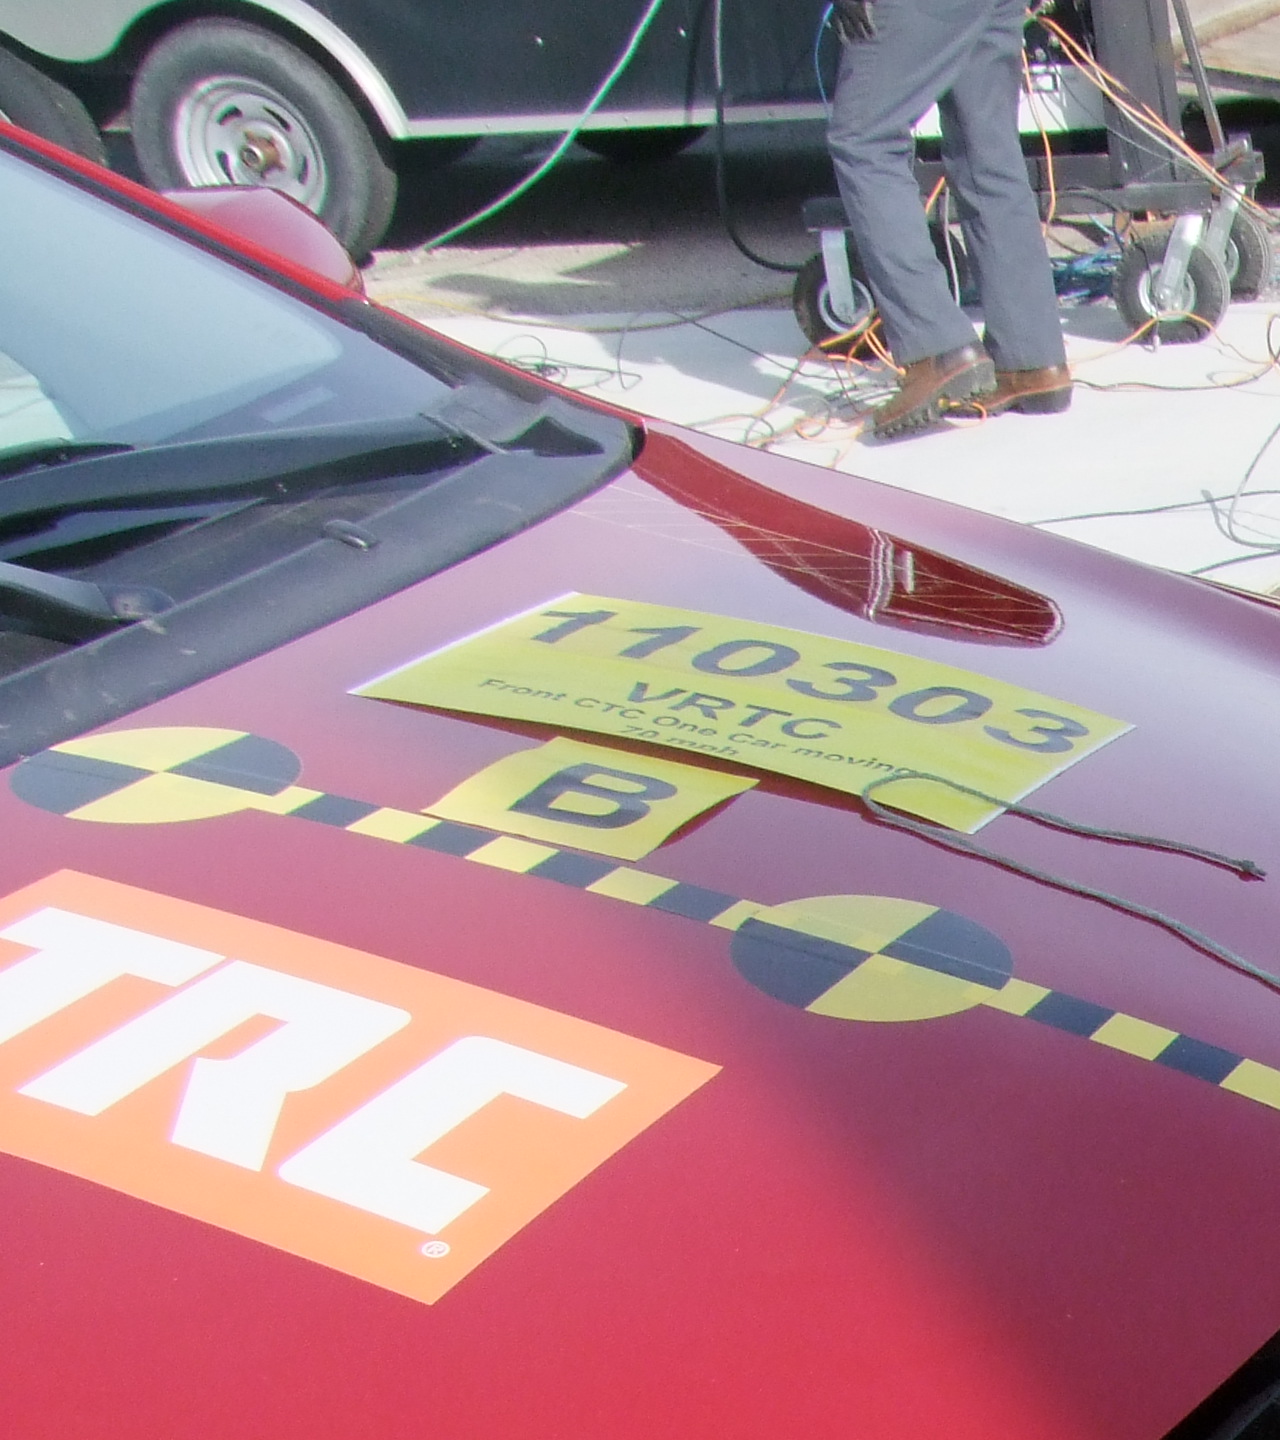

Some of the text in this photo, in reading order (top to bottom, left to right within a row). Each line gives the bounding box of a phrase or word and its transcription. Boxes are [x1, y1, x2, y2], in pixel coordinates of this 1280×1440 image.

[479, 678, 567, 701] Front
[574, 697, 645, 720] CTC
[652, 715, 718, 738] One
[728, 732, 786, 750] Car
[531, 610, 1089, 754] 110303
[628, 680, 842, 739] VRTC
[507, 762, 678, 830] B
[0, 906, 629, 1235] TRC
